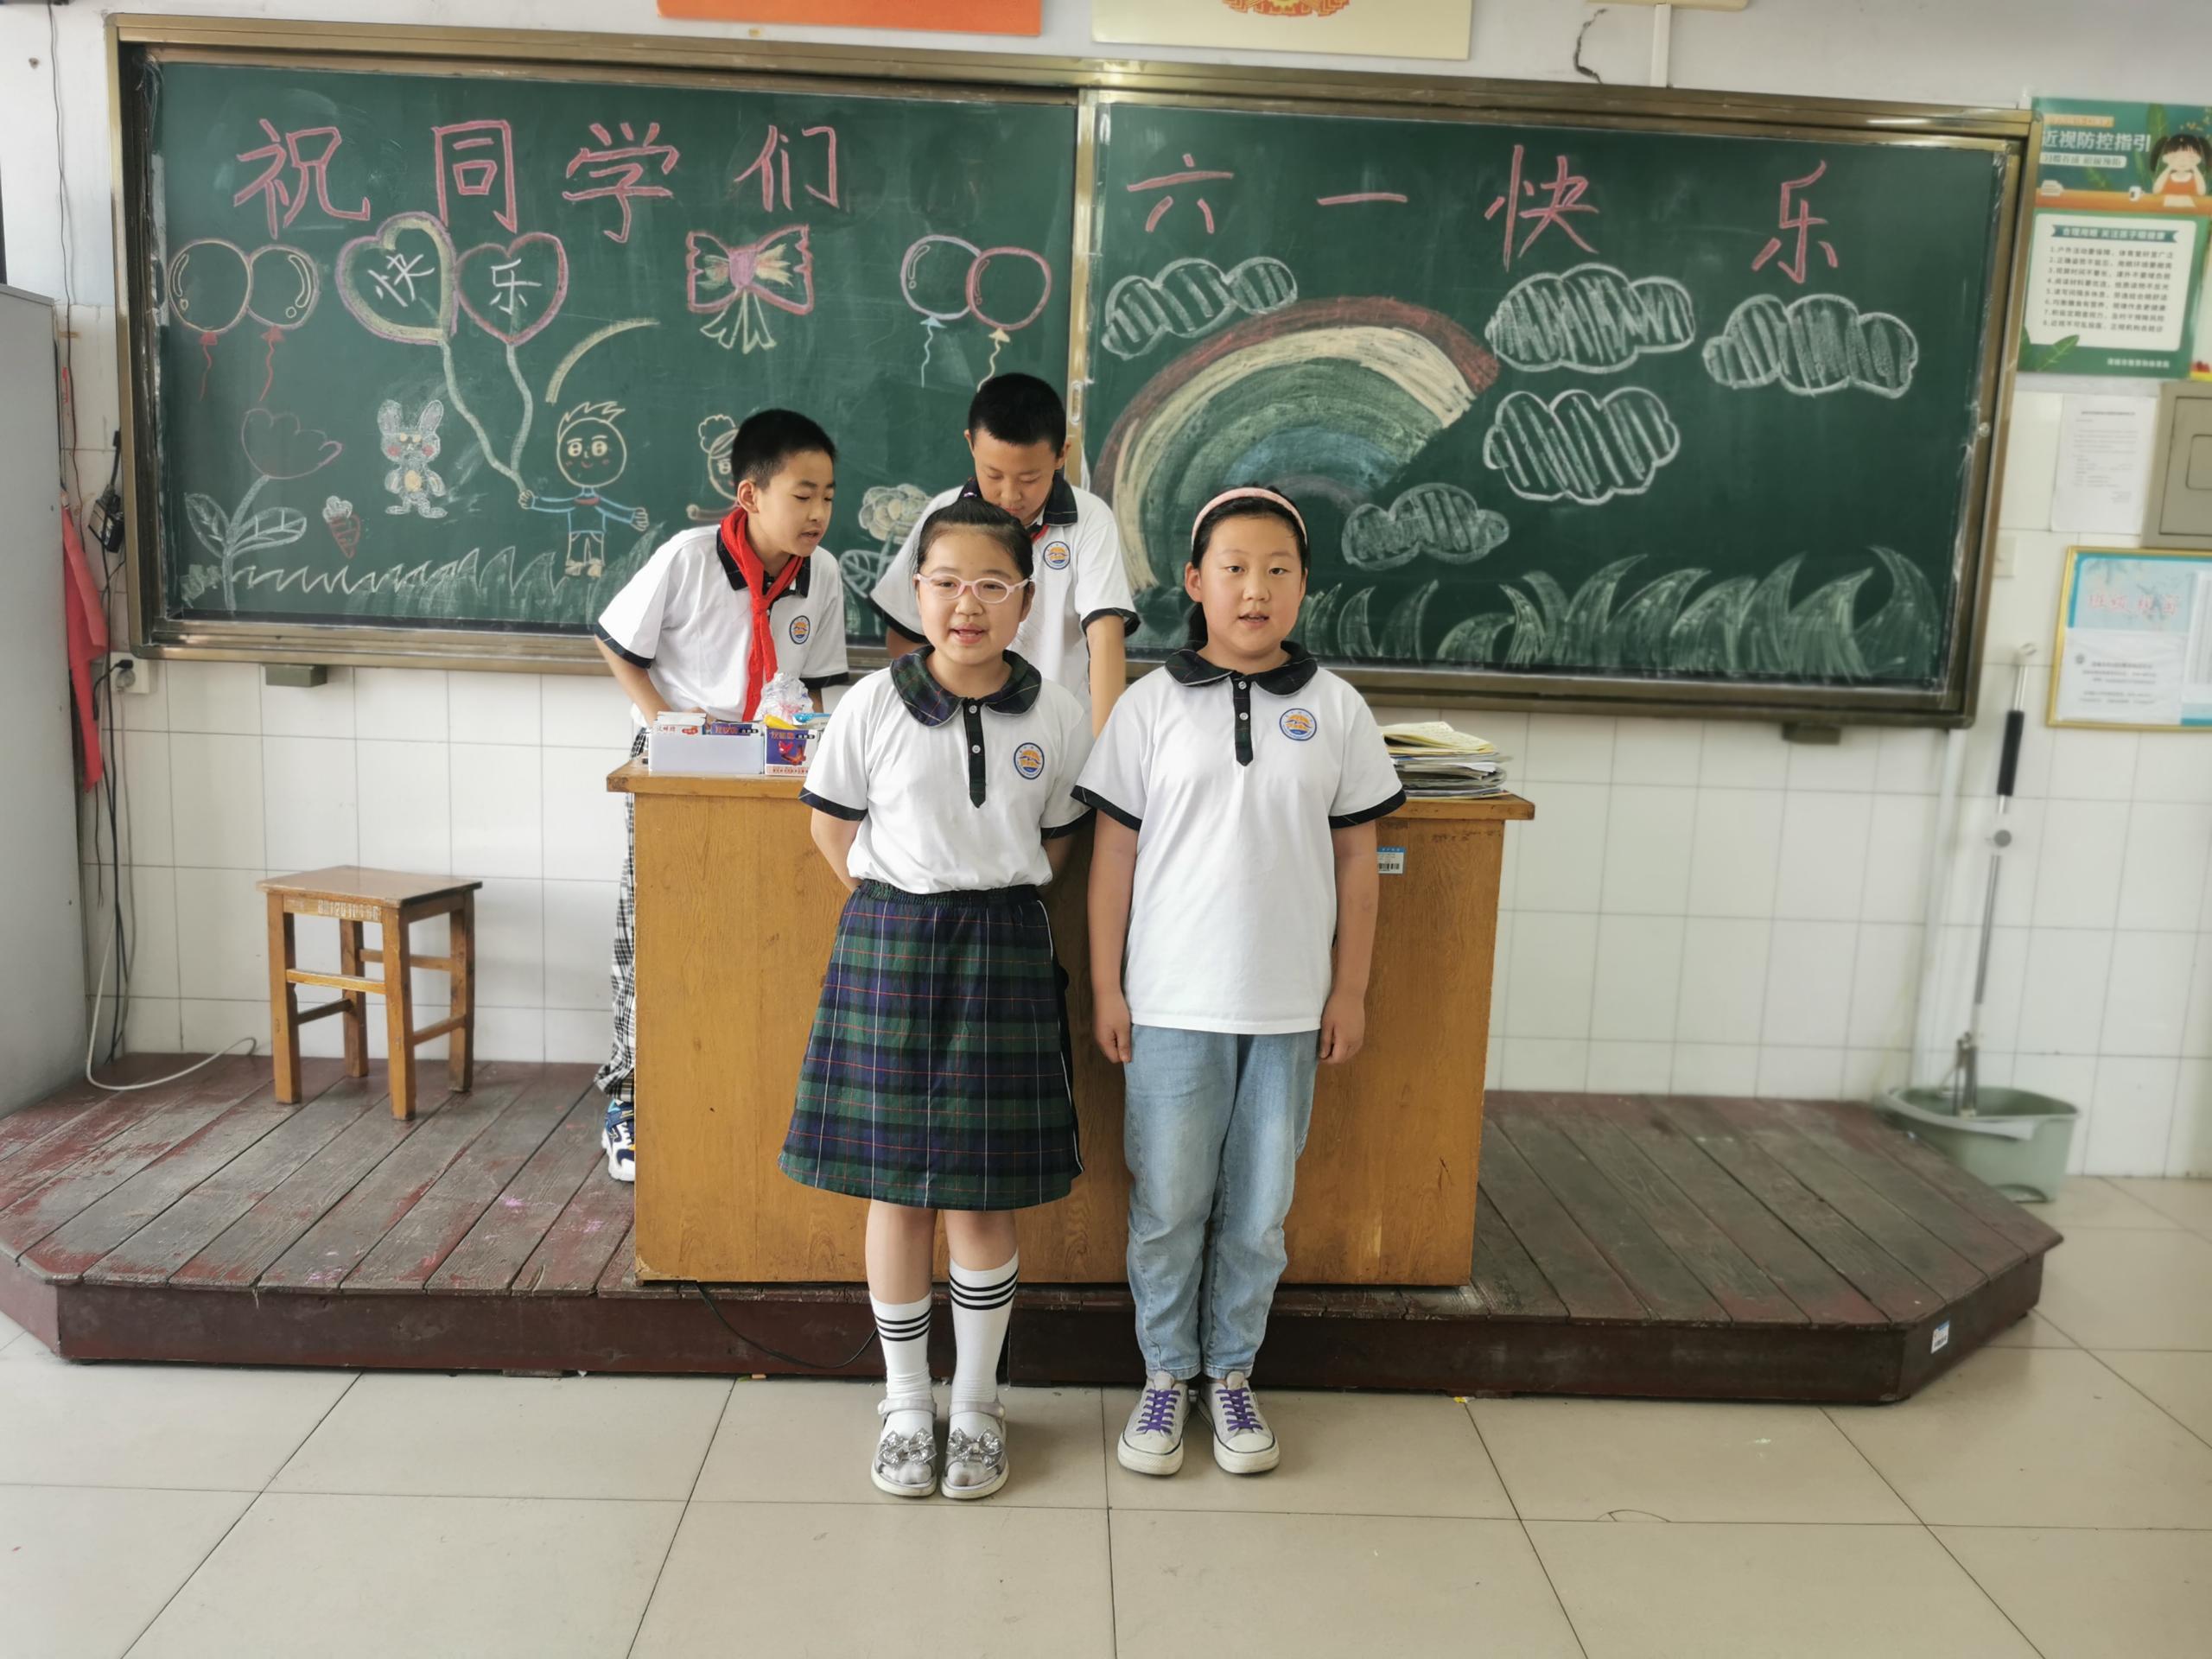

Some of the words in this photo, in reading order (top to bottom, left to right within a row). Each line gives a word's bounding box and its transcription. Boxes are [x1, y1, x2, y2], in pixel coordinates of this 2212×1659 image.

[233, 118, 841, 243] 祝同学们
[2042, 130, 2152, 152] 近视防控指引
[1127, 143, 1840, 284] 六一快乐
[368, 252, 435, 308] 快
[489, 257, 541, 315] 乐
